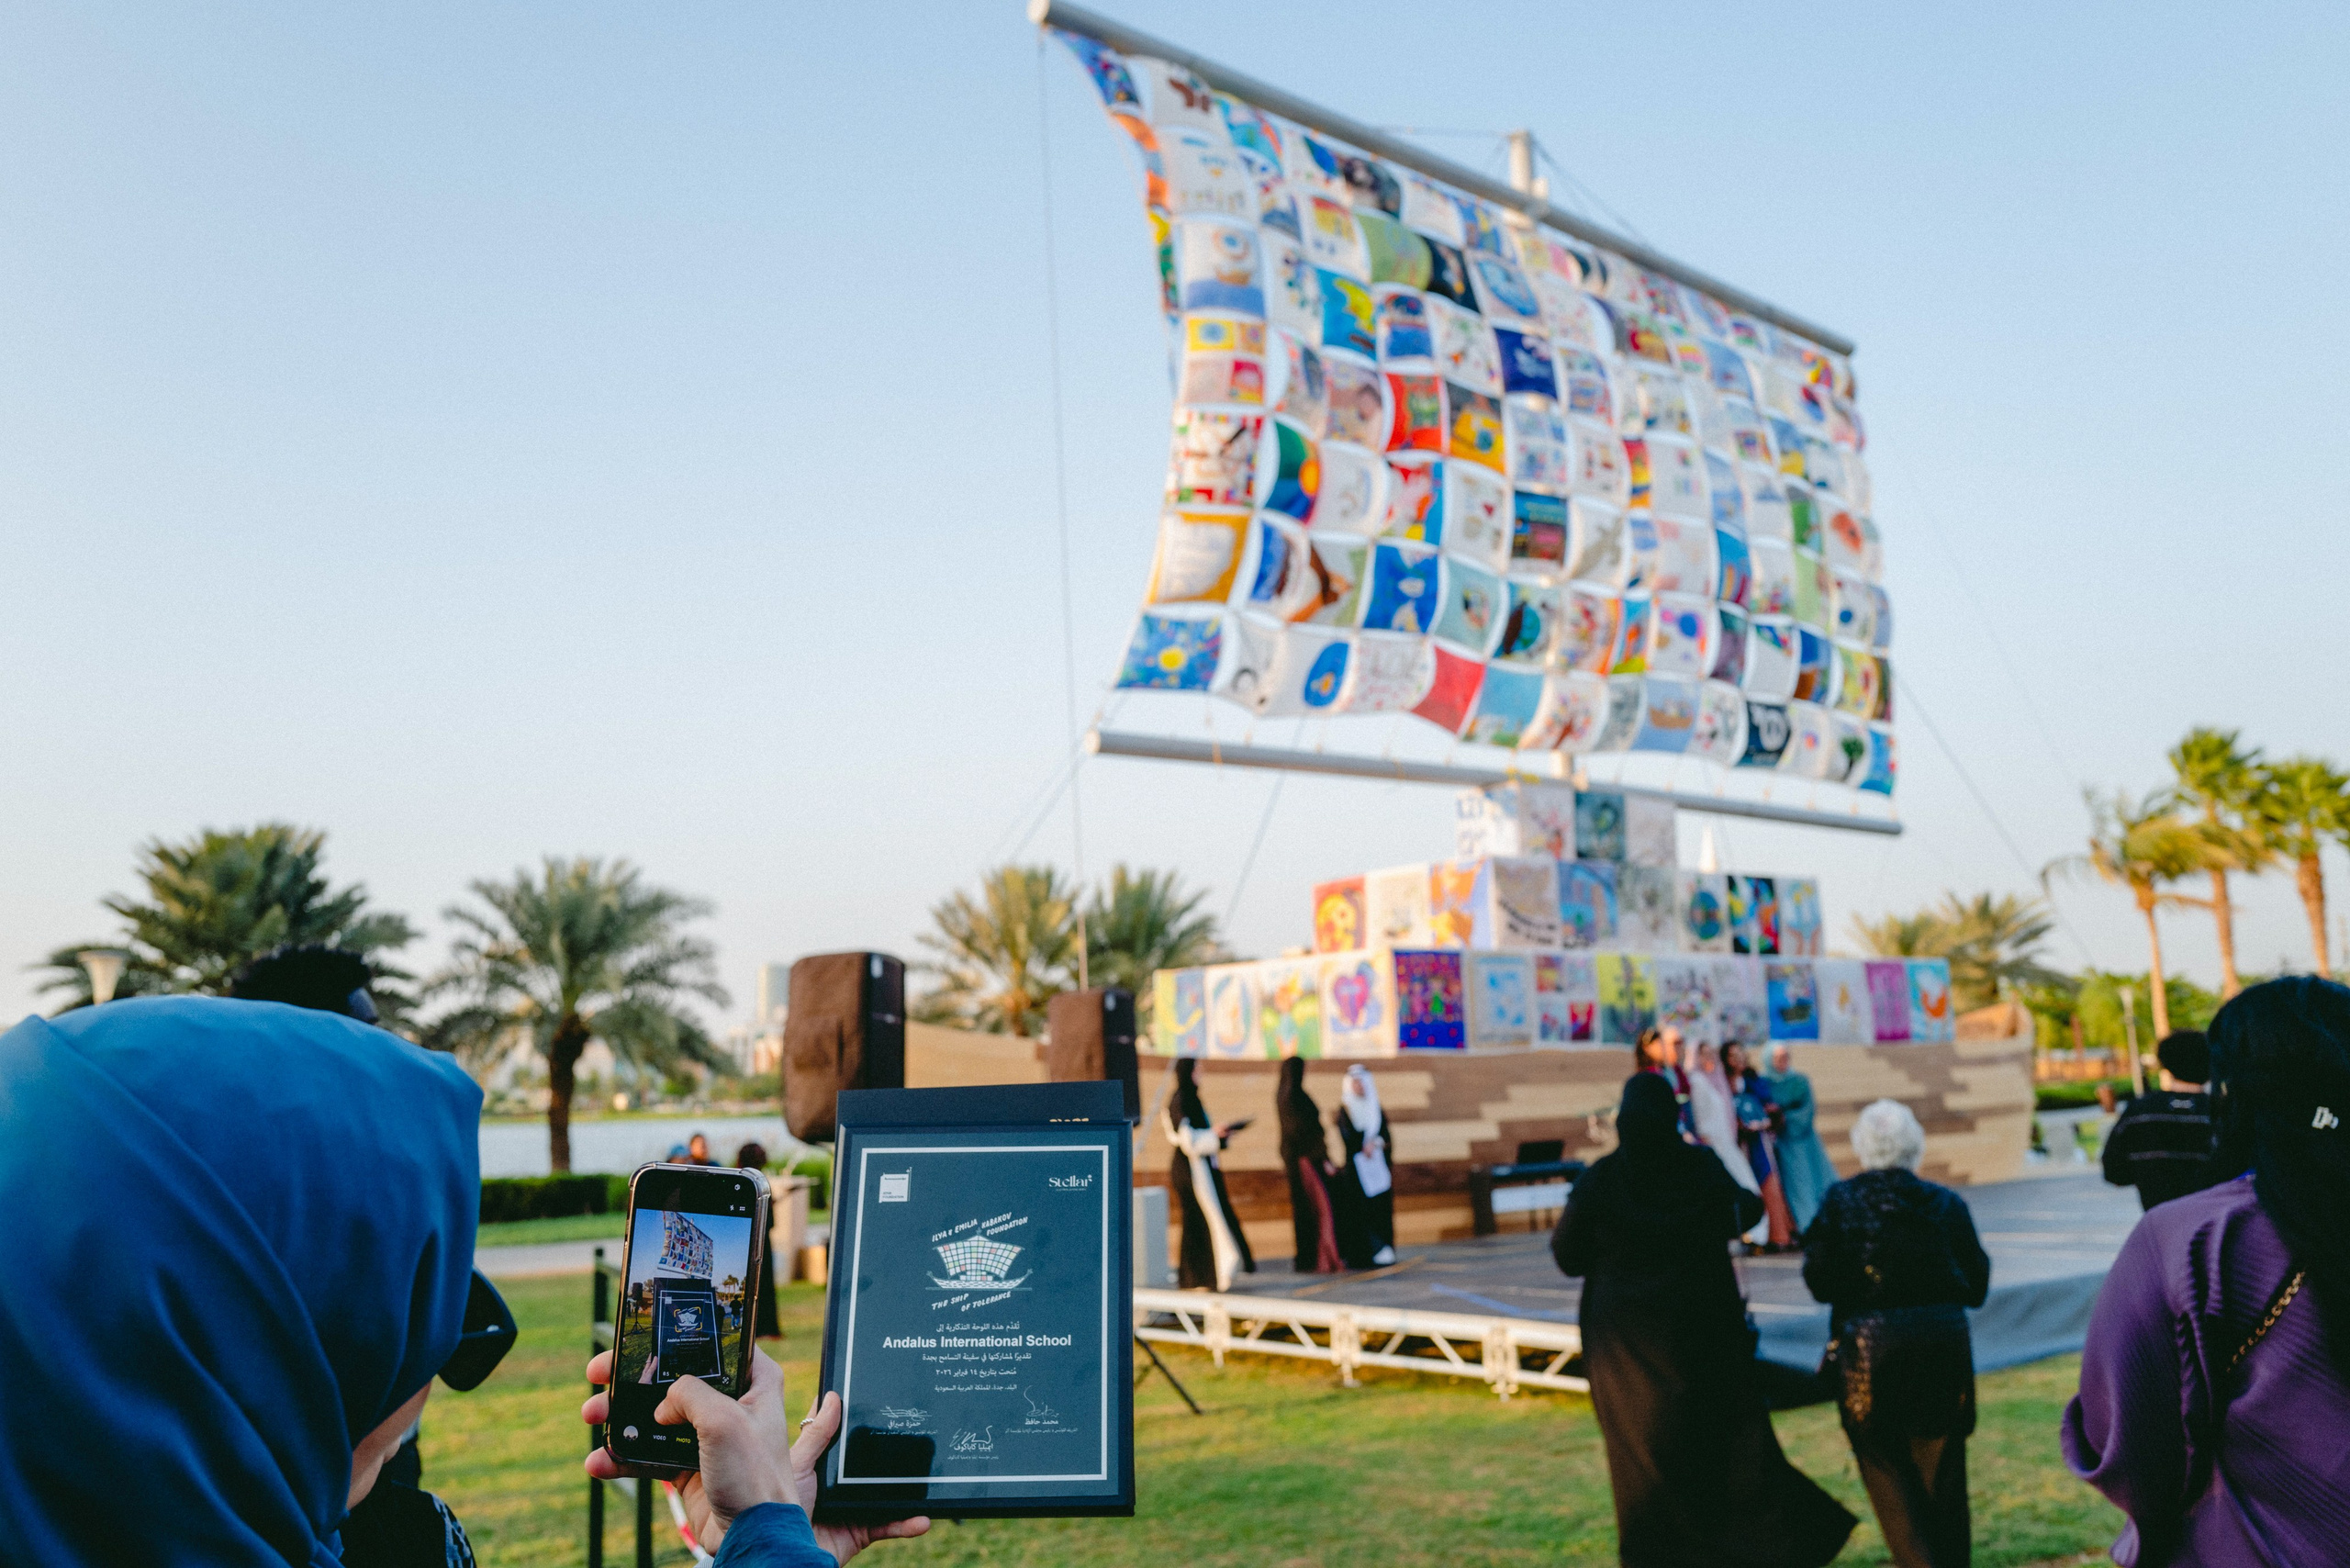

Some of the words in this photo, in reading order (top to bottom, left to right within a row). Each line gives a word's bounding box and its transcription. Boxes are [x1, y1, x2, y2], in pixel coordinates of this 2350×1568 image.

[1048, 1174, 1092, 1187] Stellar
[932, 1230, 947, 1242] ILYA
[955, 1218, 978, 1233] EMILIA
[981, 1212, 1012, 1228] KABAKOV
[986, 1216, 1028, 1236] FOUNDATION
[932, 1299, 948, 1310] THE
[950, 1293, 969, 1304] SHIP
[961, 1303, 971, 1312] OF
[972, 1291, 1012, 1308] TOLERANCE
[946, 1323, 970, 1332] التذكارية
[971, 1323, 990, 1331] اللوحة
[882, 1337, 937, 1349] Andalus
[941, 1335, 1022, 1348] International
[1025, 1334, 1071, 1348] School
[938, 1353, 961, 1362] التسامح
[962, 1353, 979, 1361] سفينة
[980, 1353, 987, 1362] في
[988, 1352, 1013, 1361] لمشاركتها
[953, 1369, 968, 1377] فبراير
[979, 1368, 997, 1378] بتاريخ
